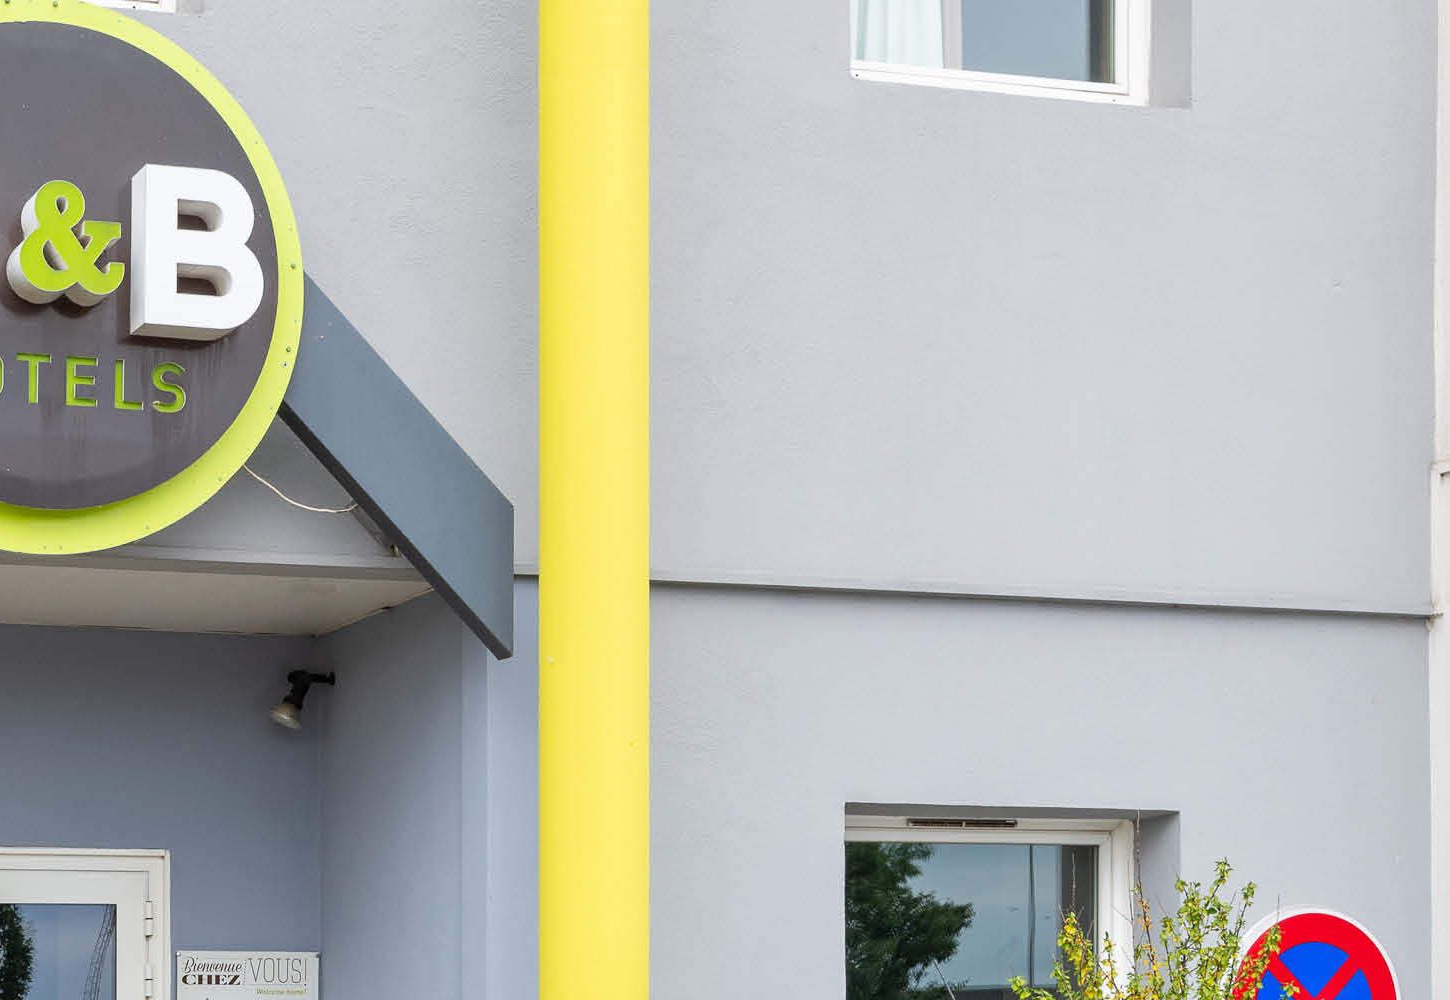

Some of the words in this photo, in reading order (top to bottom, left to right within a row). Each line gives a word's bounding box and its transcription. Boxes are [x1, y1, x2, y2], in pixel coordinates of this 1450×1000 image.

[182, 957, 242, 973] Bienvenue
[248, 958, 308, 986] VOUS!
[182, 974, 241, 985] CHEZ
